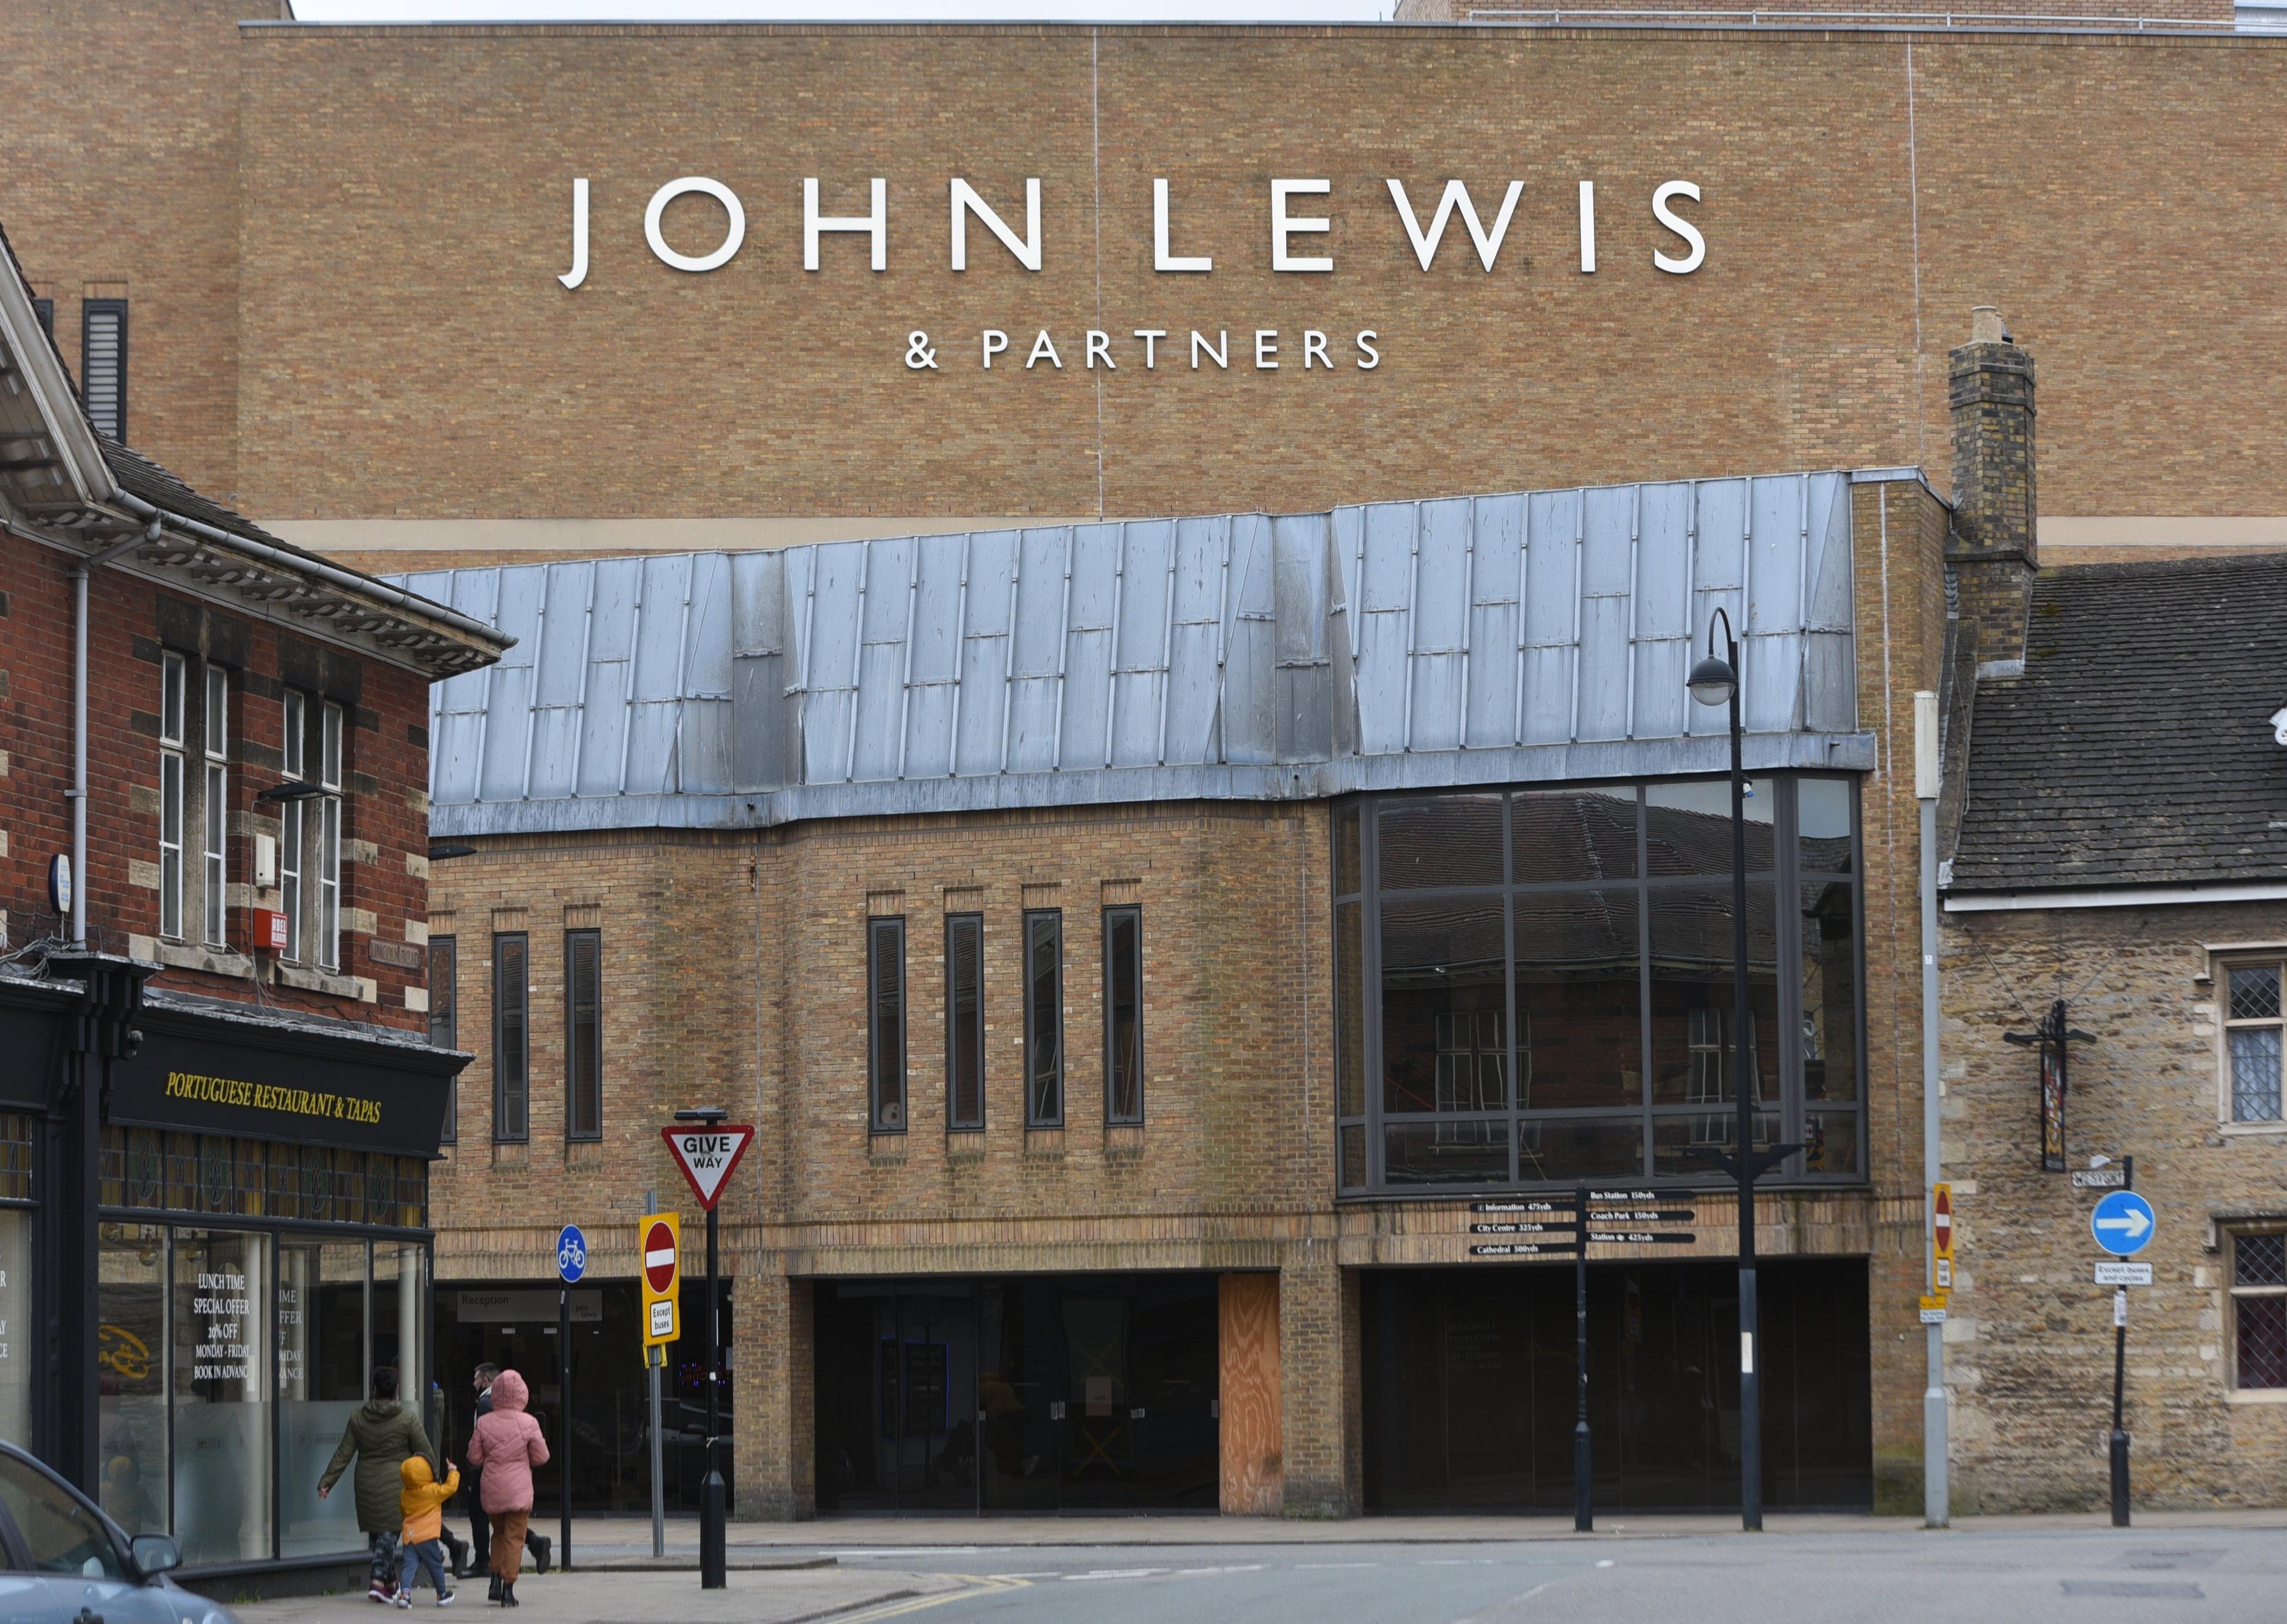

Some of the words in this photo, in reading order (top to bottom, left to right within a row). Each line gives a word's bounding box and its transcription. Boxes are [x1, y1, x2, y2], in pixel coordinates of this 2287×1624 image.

[557, 176, 1042, 289] JOHN
[1153, 178, 1706, 274] LEWIS
[904, 330, 938, 370] &
[983, 330, 1380, 370] PARTNERS
[370, 941, 400, 961] LINCOLN
[401, 948, 421, 966] ROAD
[165, 1071, 251, 1106] PORTUGUESE
[253, 1084, 336, 1117] RESTAURANT
[334, 1096, 344, 1118] &
[345, 1097, 381, 1124] TAPAS
[683, 1136, 731, 1153] GIVE
[693, 1157, 723, 1169] WAY
[1590, 1191, 1603, 1200] Bus
[1603, 1191, 1628, 1200] Station
[1630, 1190, 1656, 1201] 150yds
[1485, 1202, 1525, 1212] Information
[1527, 1202, 1552, 1212] 475yds
[1590, 1211, 1613, 1220] Coach
[1614, 1212, 1630, 1220] Park
[1633, 1211, 1659, 1221] 150yds
[1477, 1224, 1492, 1233] City
[1492, 1224, 1516, 1232] Centre
[1590, 1232, 1615, 1242] Station
[1477, 1245, 1511, 1254] Cathedral
[198, 1273, 225, 1290] LUNCH
[226, 1274, 245, 1290] TIME
[194, 1297, 225, 1314] SPECIAL
[225, 1298, 250, 1315] OFFER
[461, 1294, 509, 1308] Reception
[575, 1304, 589, 1312] John
[581, 1310, 597, 1319] Lewis
[653, 1306, 671, 1317] Except
[208, 1323, 222, 1339] 20%
[222, 1323, 238, 1339] OFF
[654, 1320, 670, 1330] buses
[195, 1344, 224, 1359] MONDAY
[228, 1344, 251, 1359] FRIDAY
[194, 1365, 213, 1380] BOOK
[214, 1365, 221, 1379] IN
